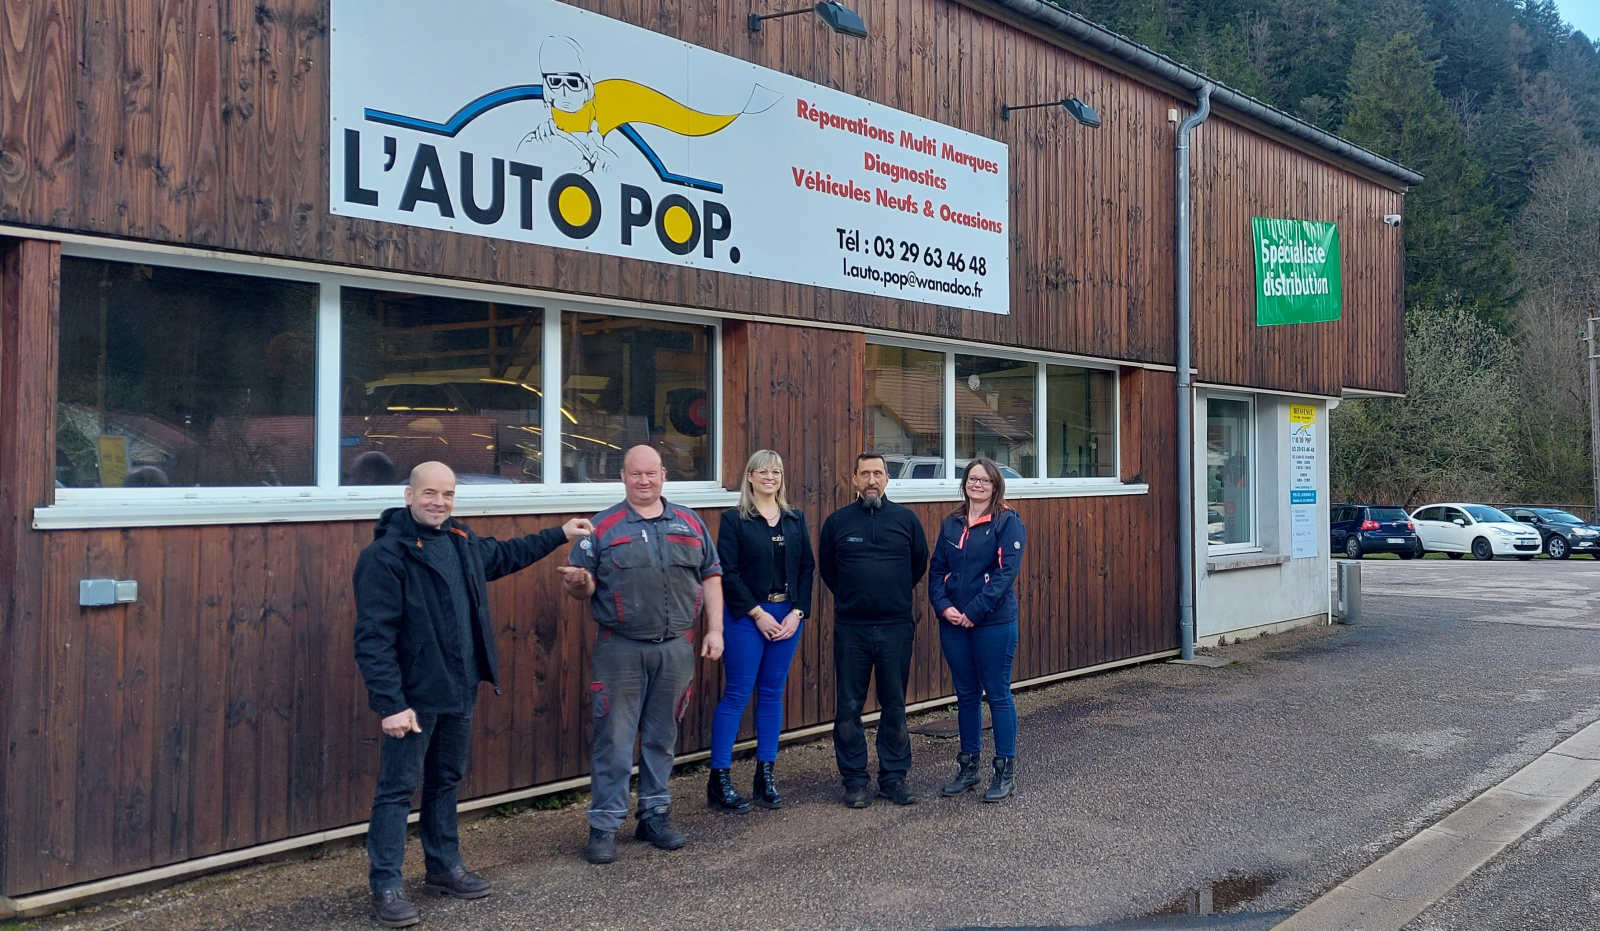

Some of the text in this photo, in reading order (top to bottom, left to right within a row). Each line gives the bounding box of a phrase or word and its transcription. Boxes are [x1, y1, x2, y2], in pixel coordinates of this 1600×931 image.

[797, 98, 998, 174] Réparations Multi Marques
[865, 152, 947, 190] Diagnostics
[344, 128, 740, 264] L'AUTO POP.
[791, 167, 1002, 234] Véhicules Neufs & Occasions
[836, 228, 859, 252] Tél
[874, 235, 895, 259] 03
[899, 241, 920, 263] 29
[923, 247, 943, 268] 63
[946, 251, 965, 272] 46
[968, 256, 987, 276] 48
[1261, 239, 1326, 269] Spécialiste
[843, 257, 983, 298] l.auto.pop@wanadoo.fr
[1263, 271, 1329, 297] distribution
